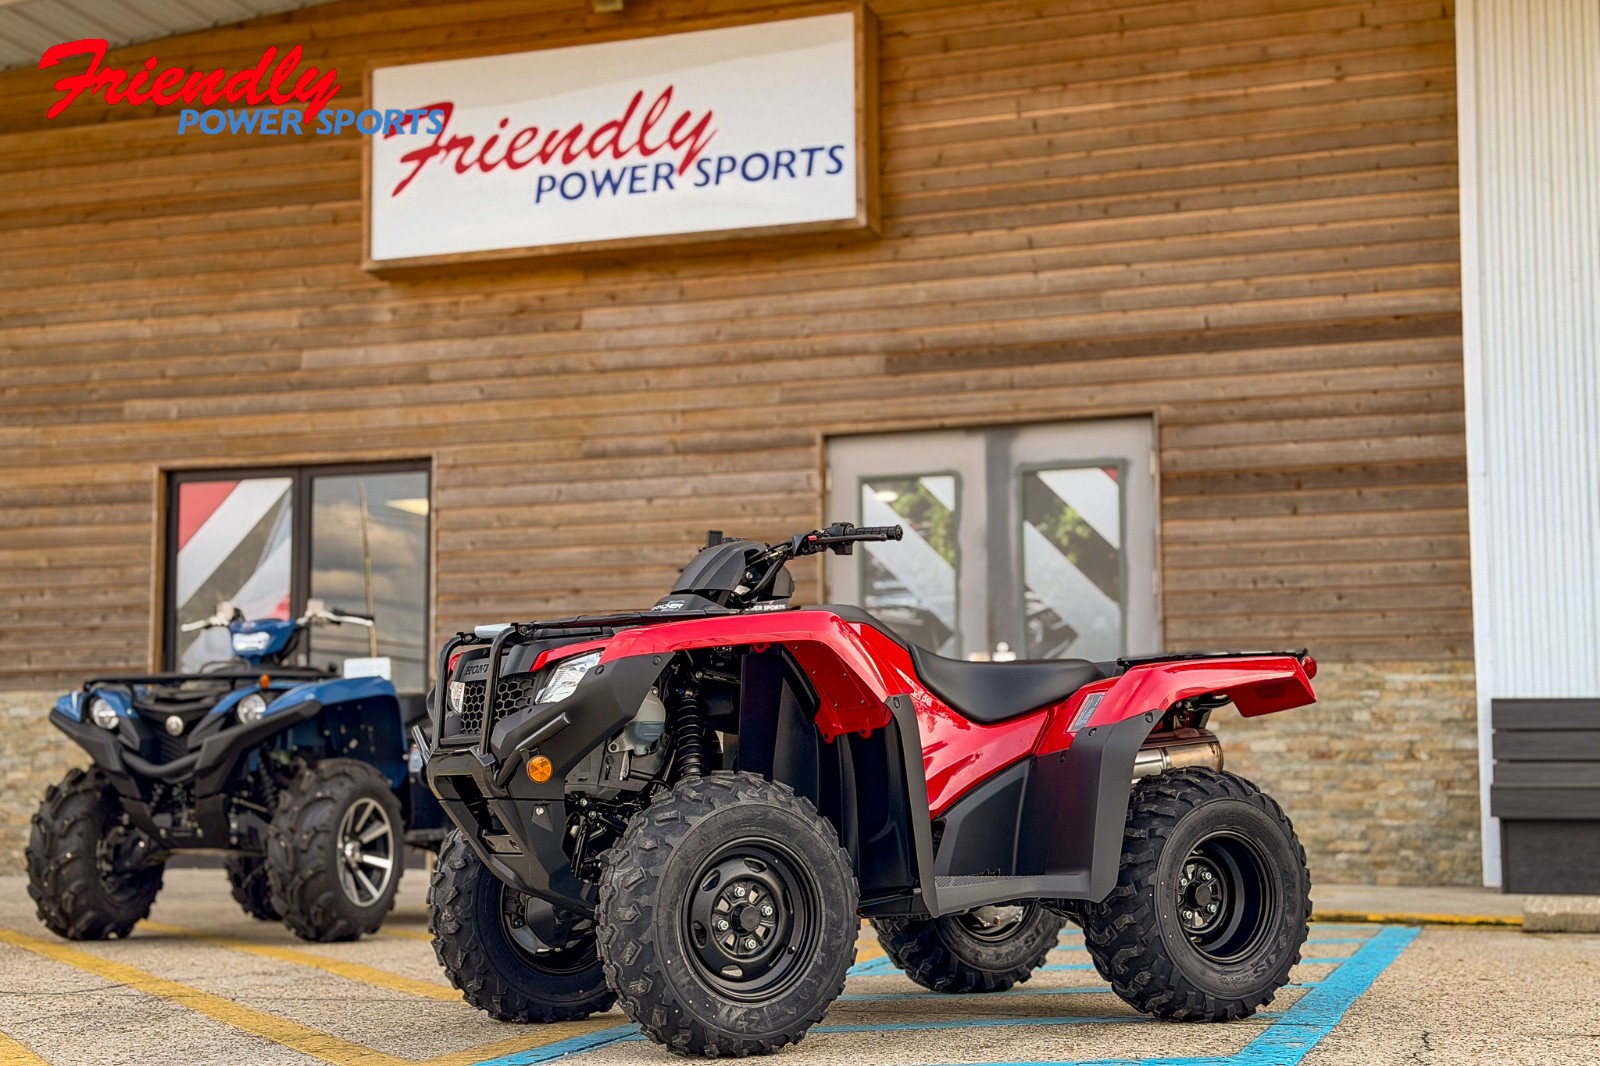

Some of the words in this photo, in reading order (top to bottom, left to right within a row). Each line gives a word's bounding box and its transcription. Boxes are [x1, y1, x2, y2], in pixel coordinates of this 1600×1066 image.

[384, 85, 718, 197] Friendly
[535, 162, 675, 204] POWER
[694, 145, 844, 187] SPORTS
[464, 663, 489, 676] HON
